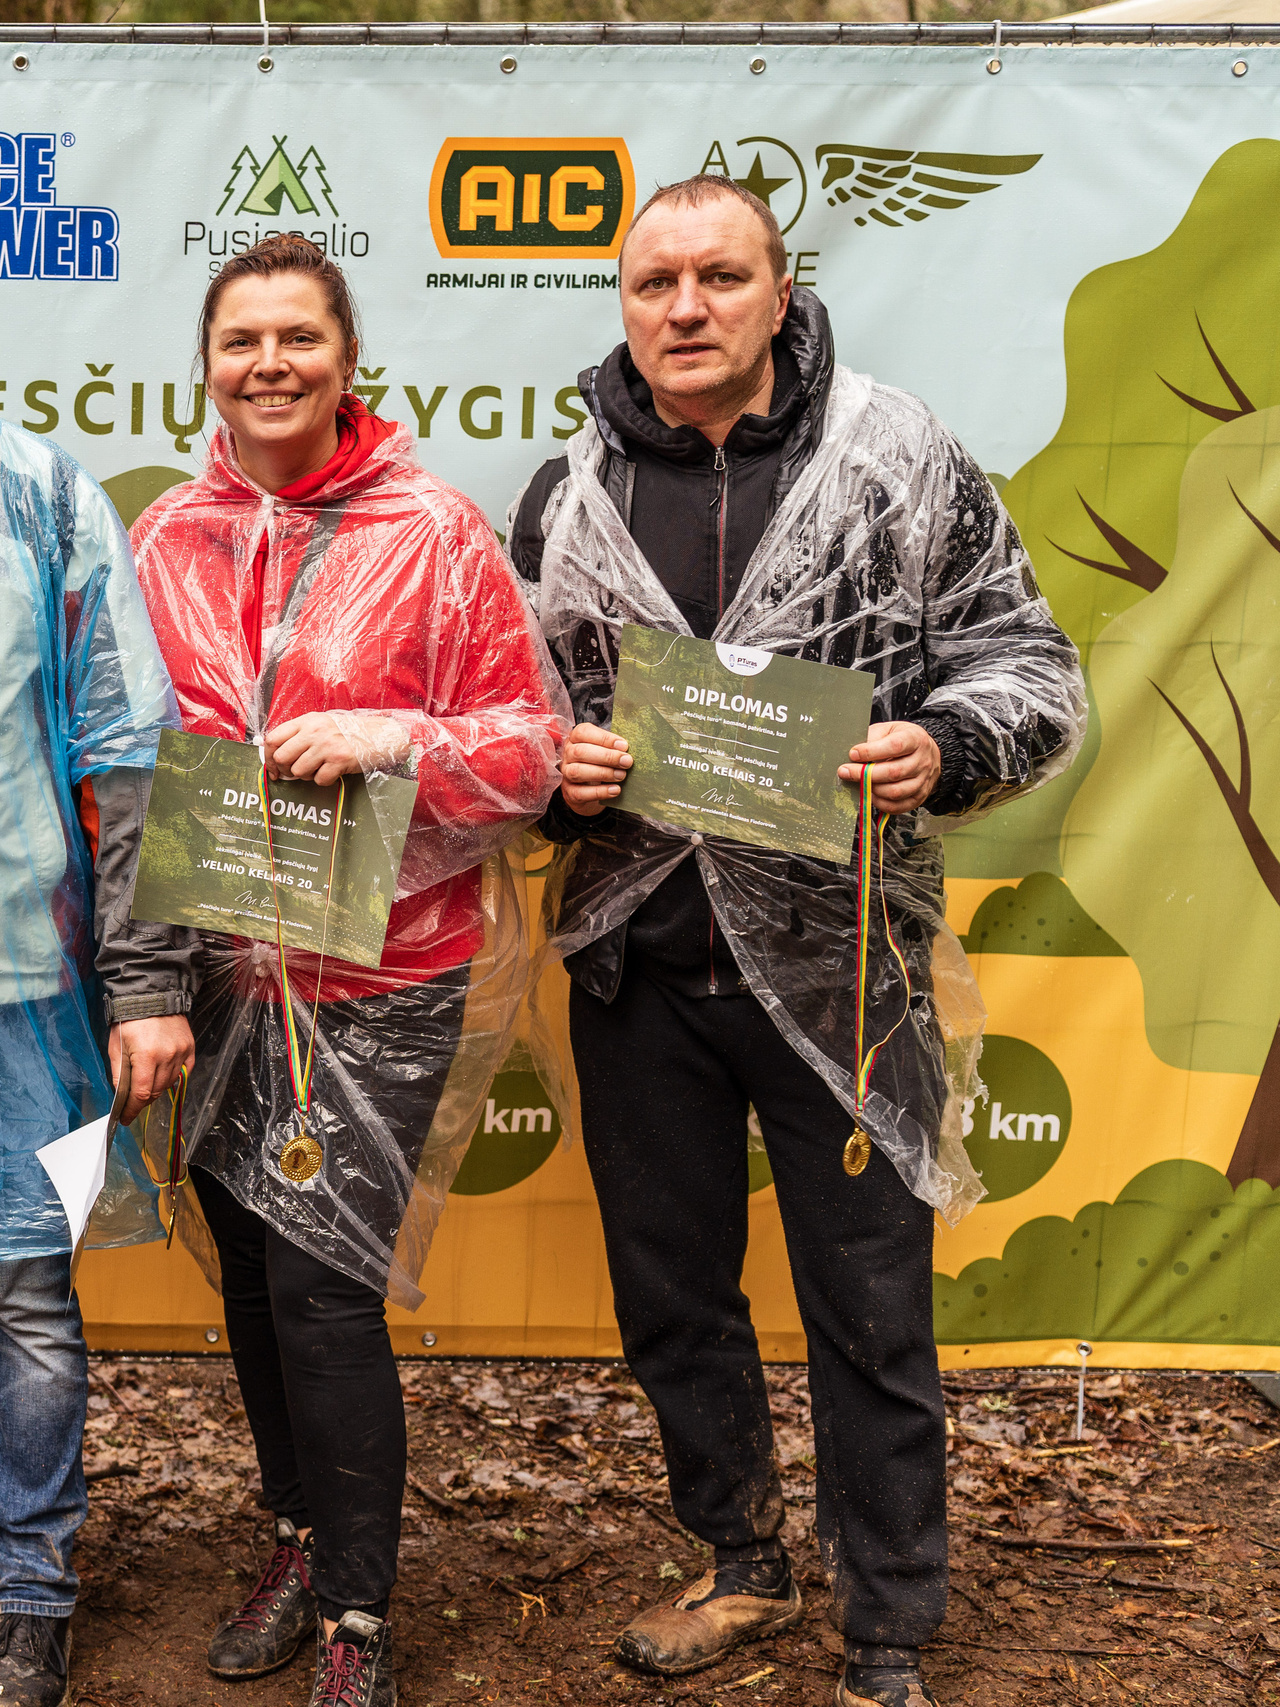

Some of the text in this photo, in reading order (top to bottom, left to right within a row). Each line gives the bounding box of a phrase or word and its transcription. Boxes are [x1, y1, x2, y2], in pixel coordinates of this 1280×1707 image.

[459, 165, 605, 231] AIC
[426, 273, 620, 289] ARMIJAI IR CIVILIAM
[684, 685, 788, 723] DIPLOMAS
[712, 765, 756, 784] KELIAIS
[484, 1099, 552, 1134] km
[989, 1101, 1060, 1142] km
